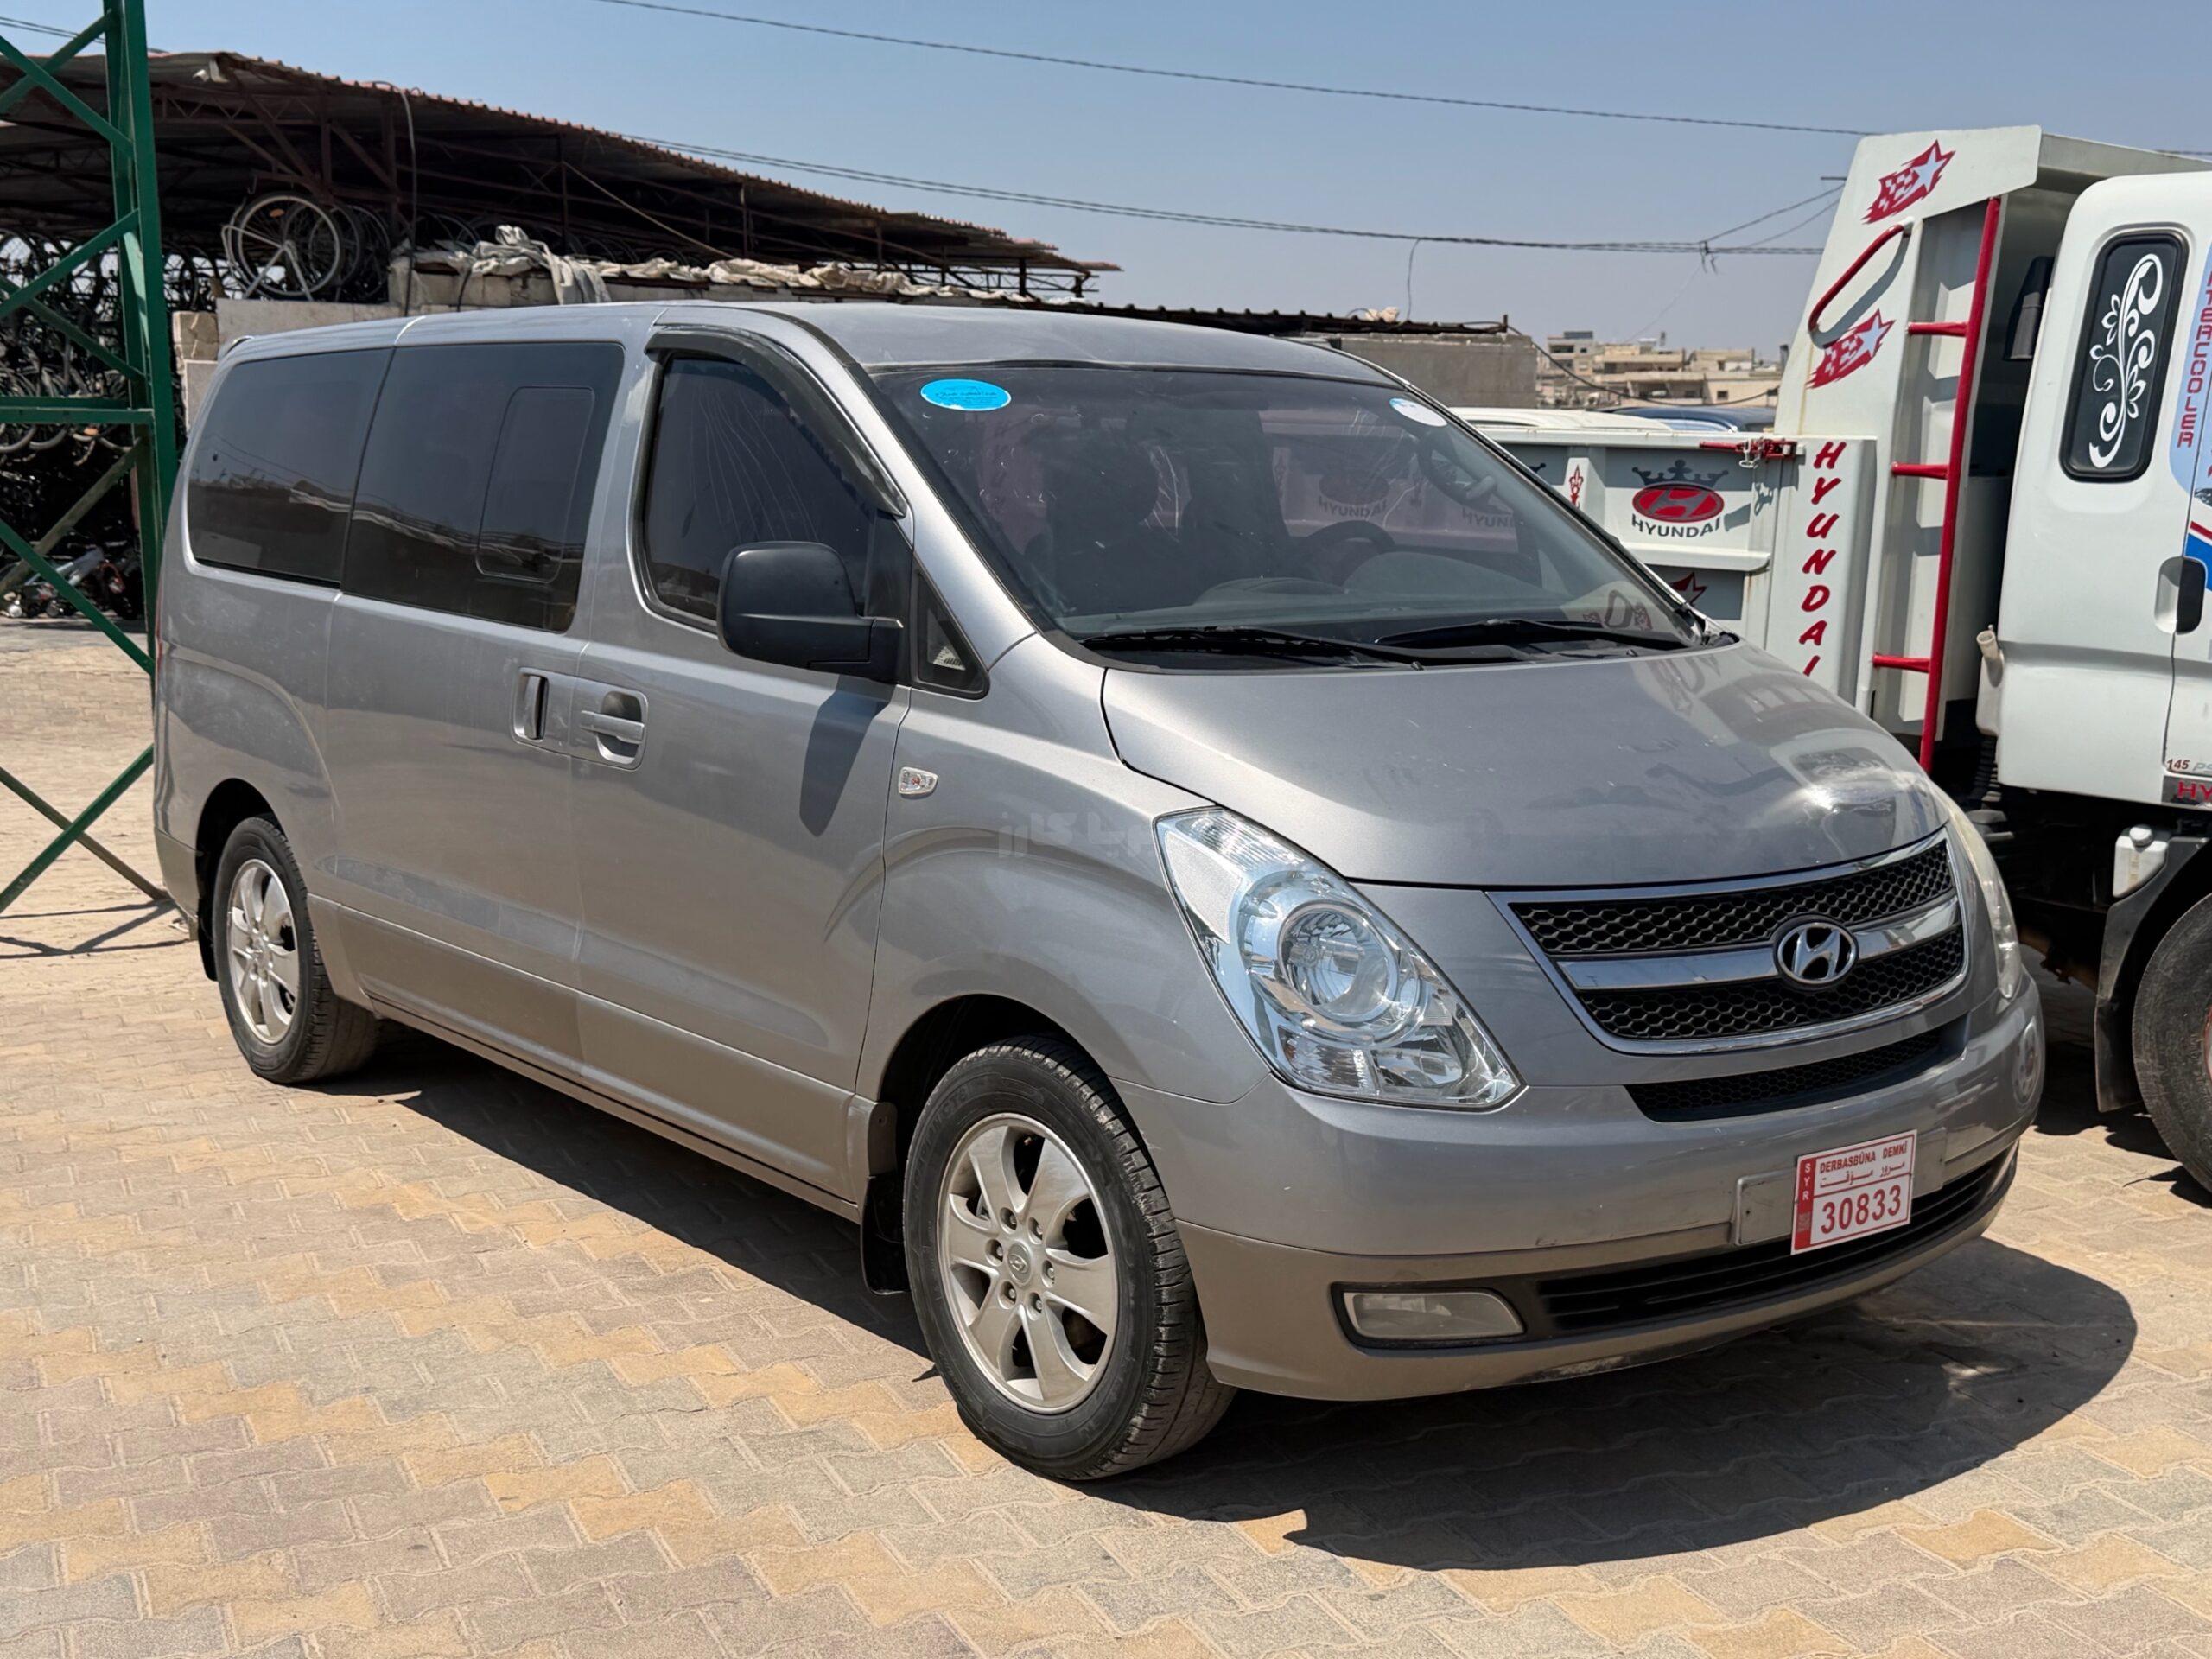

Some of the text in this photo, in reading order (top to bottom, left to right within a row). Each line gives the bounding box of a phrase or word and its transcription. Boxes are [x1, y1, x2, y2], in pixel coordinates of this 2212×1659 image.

[1462, 507, 1516, 528] HYUN
[1631, 513, 1721, 538] HYUNDAI
[1798, 441, 1847, 677] HYUNDAI
[2167, 758, 2190, 771] 145
[1802, 1163, 1811, 1200] SYR
[1821, 1185, 1901, 1235] 30833
